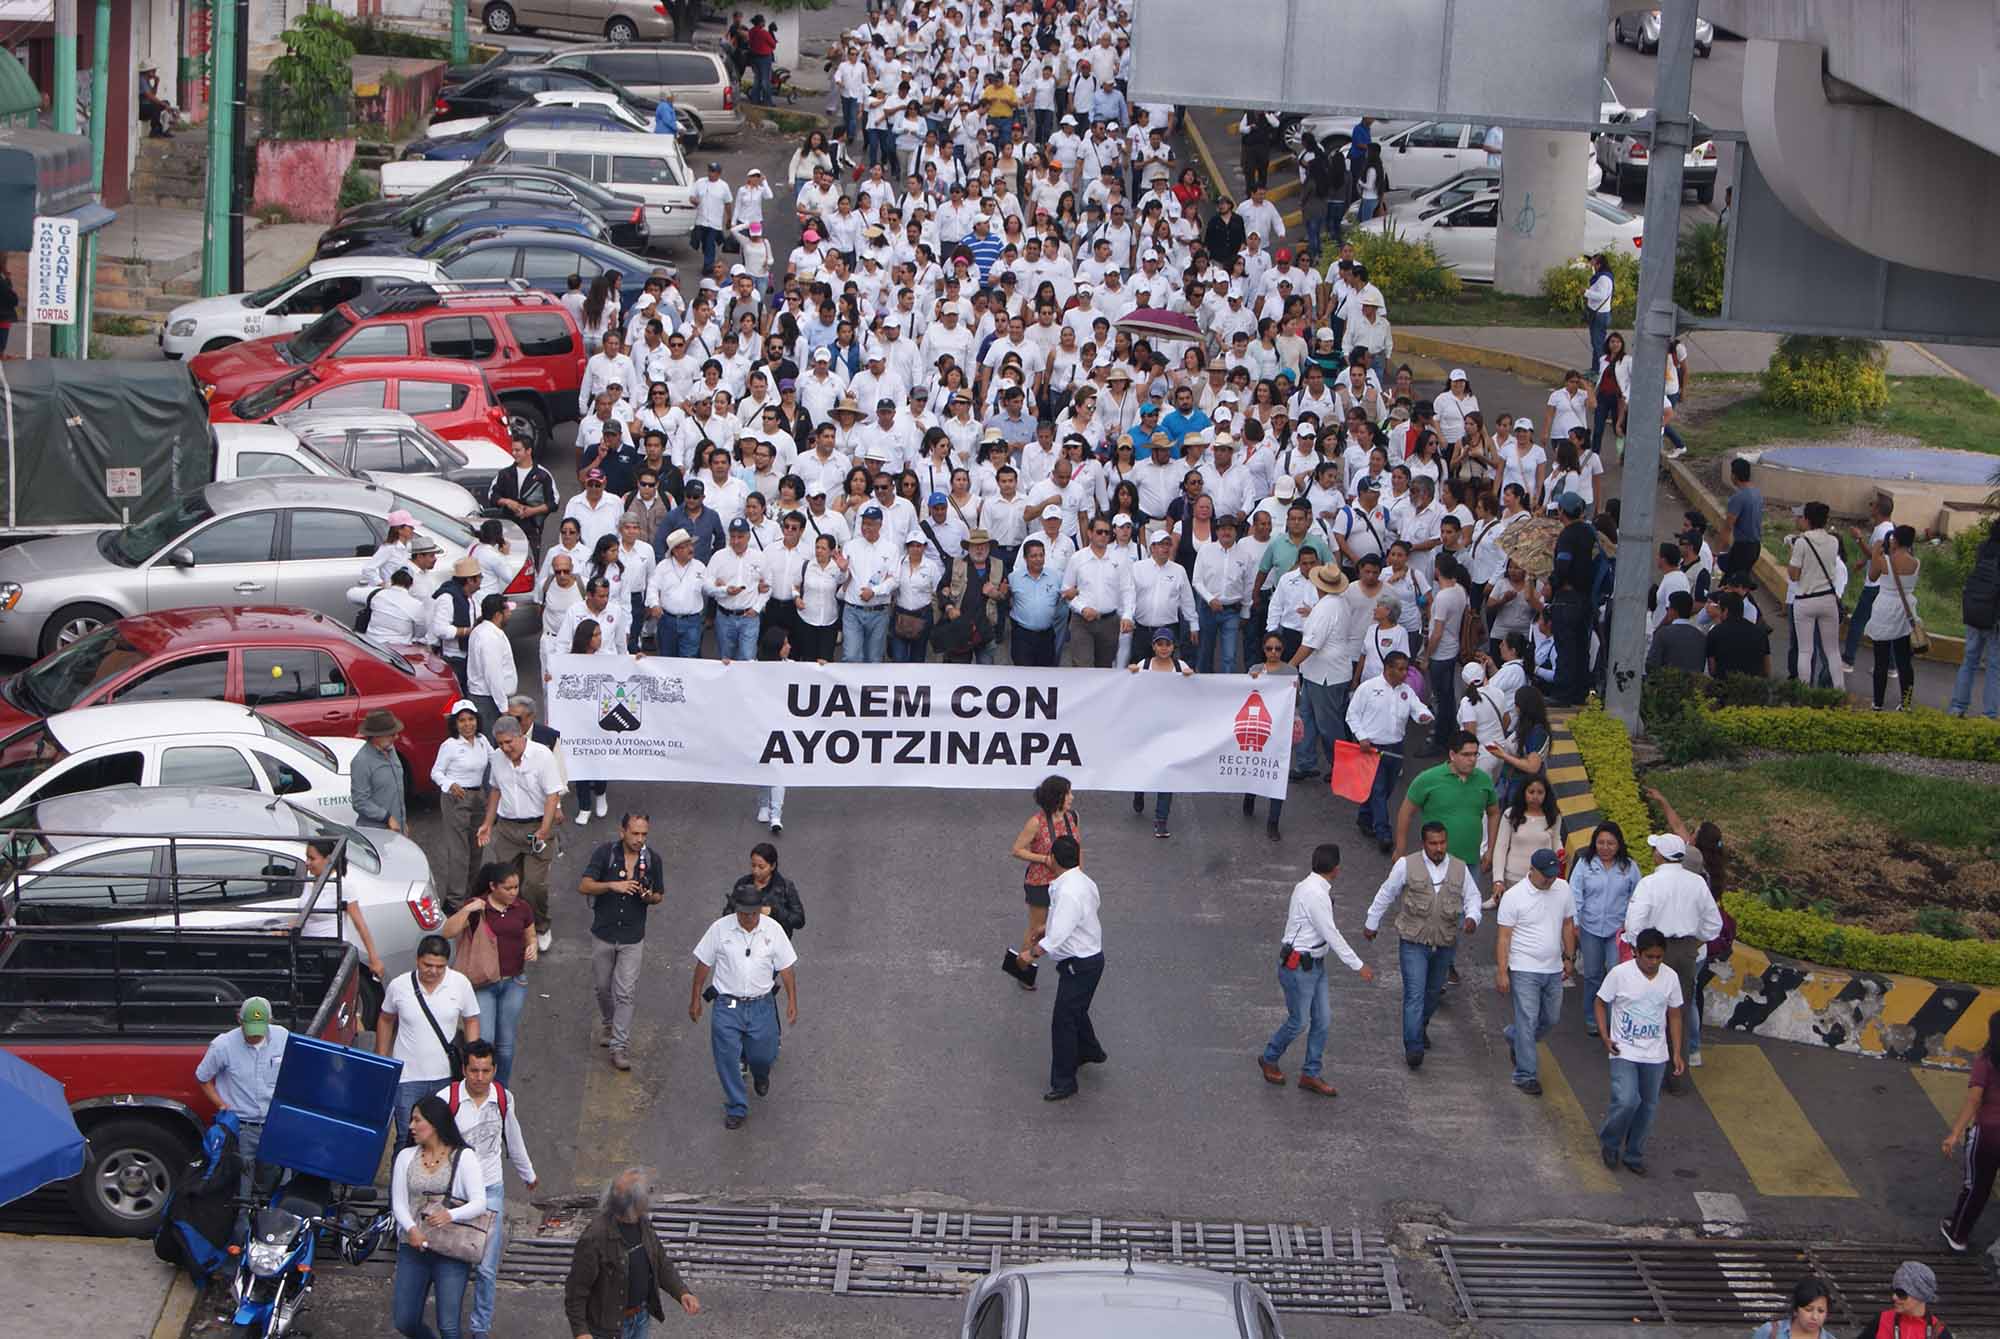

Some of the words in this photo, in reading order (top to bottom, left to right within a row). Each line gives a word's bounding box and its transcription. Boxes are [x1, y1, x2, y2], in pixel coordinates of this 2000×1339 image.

[40, 223, 53, 305] HAMBURGUESAS
[56, 225, 71, 304] GIGANTES
[36, 308, 69, 320] TORTAS
[244, 325, 260, 334] 683
[787, 683, 931, 717] UAEM
[951, 685, 1058, 720] CON
[573, 747, 606, 756] ESTADO
[609, 748, 619, 756] DE
[623, 747, 666, 757] MORELOS
[759, 729, 1082, 766] AYOTZINAPA
[1220, 766, 1278, 780] 2012-2018
